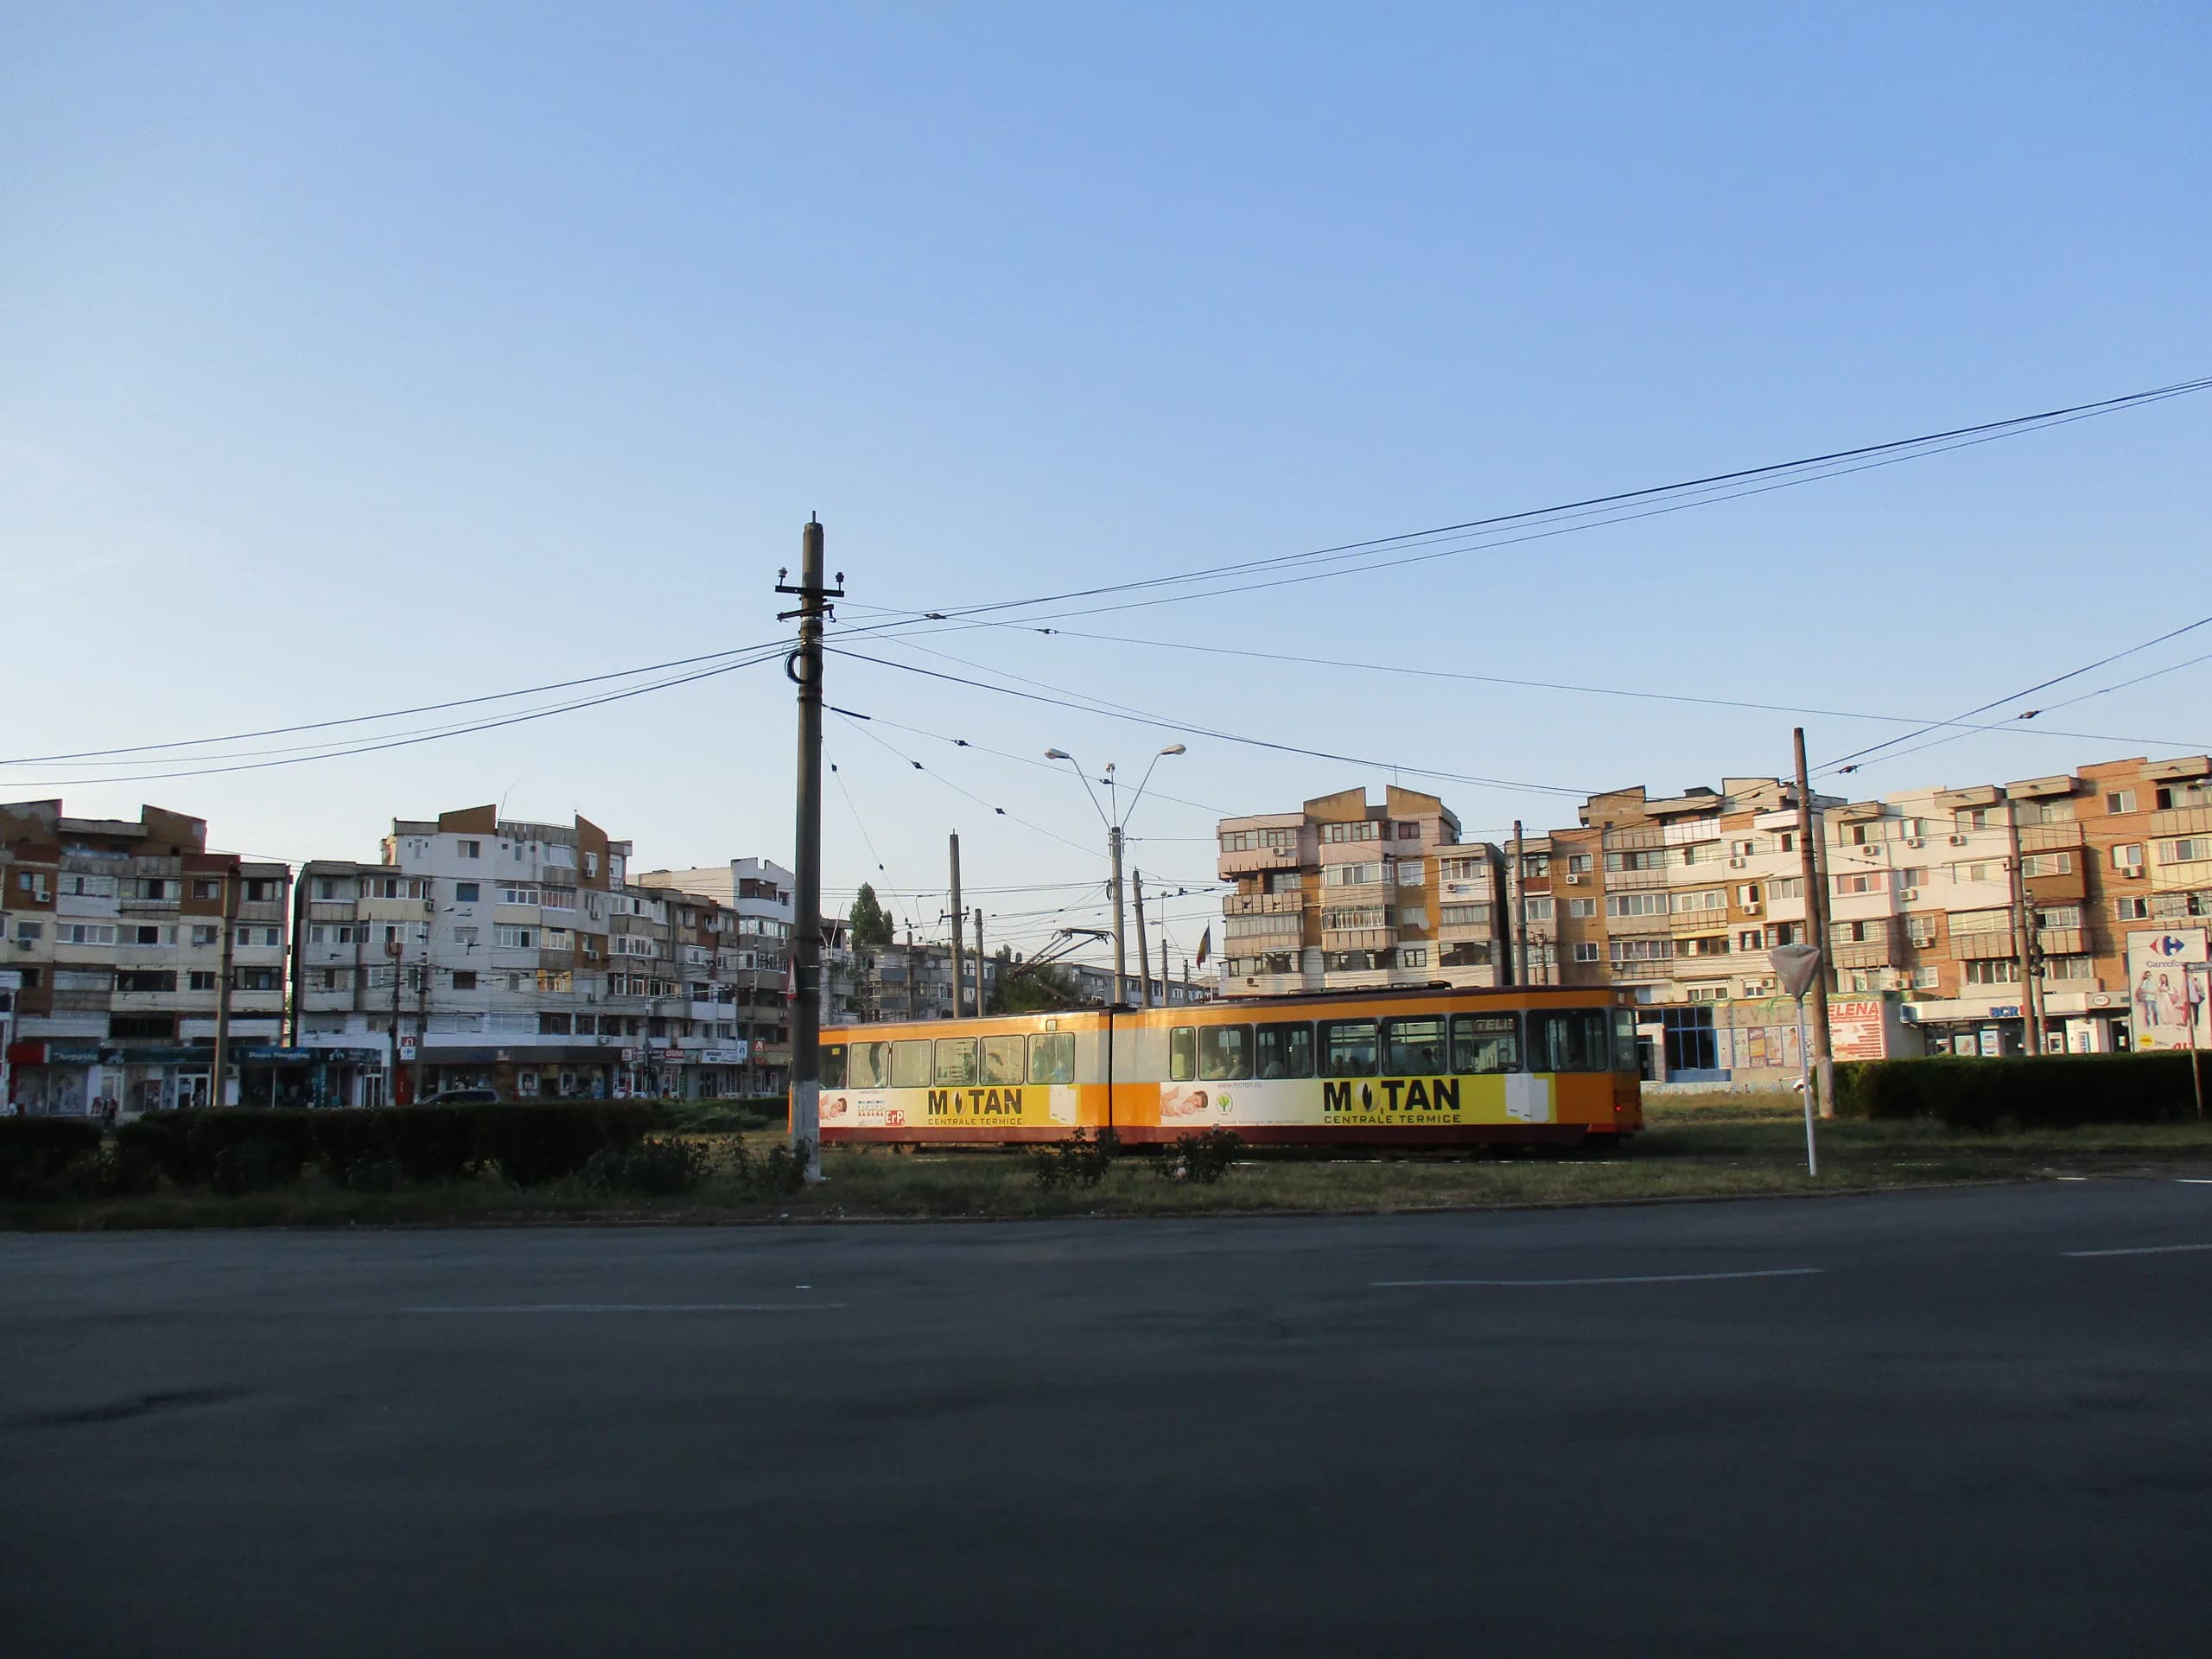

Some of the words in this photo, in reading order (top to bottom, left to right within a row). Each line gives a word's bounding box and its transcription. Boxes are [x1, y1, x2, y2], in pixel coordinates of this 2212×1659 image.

[2146, 959, 2186, 968] Carrefo
[1828, 1002, 1879, 1017] ELENA
[1990, 1006, 2019, 1018] BCR
[928, 1117, 976, 1126] CENTRALE
[1324, 1116, 1391, 1124] CENTRALE
[1399, 1115, 1461, 1123] TERMICE
